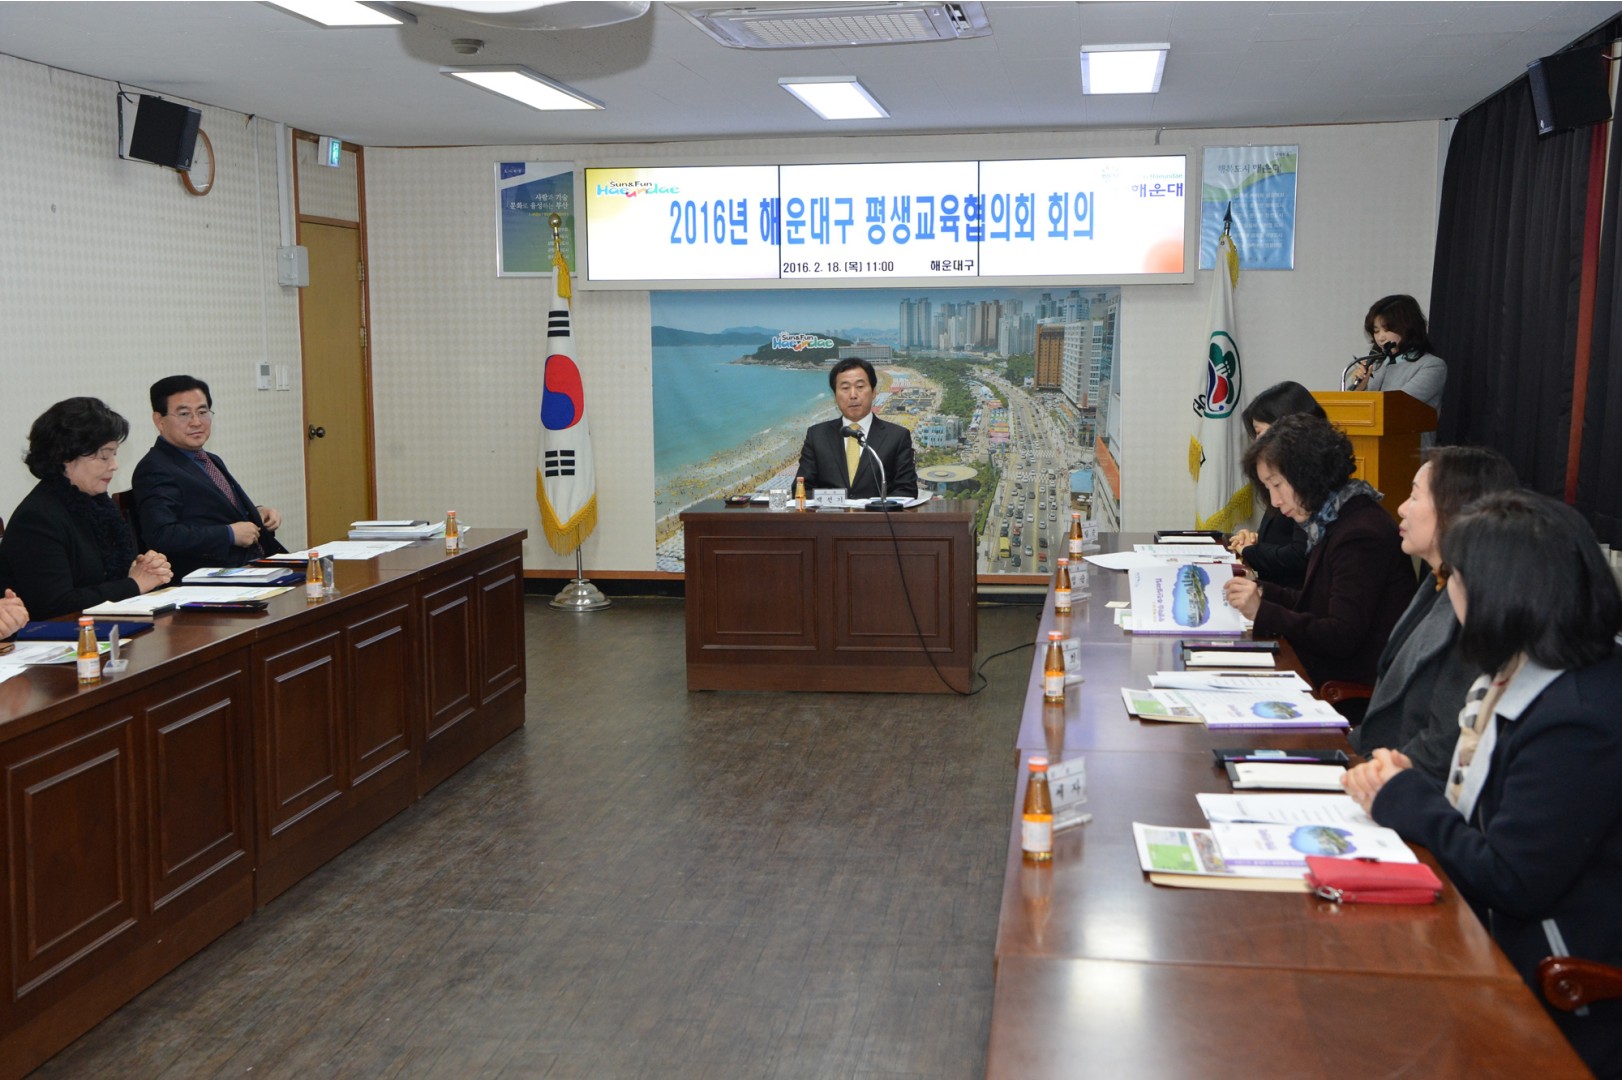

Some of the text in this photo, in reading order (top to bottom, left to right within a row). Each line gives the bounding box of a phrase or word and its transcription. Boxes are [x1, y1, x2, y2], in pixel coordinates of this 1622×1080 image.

[596, 183, 680, 198] Haeundae
[669, 191, 1095, 246] 2016년 해운대구 평생교육협의회 회의
[783, 262, 811, 273] 2016.
[814, 262, 823, 273] 2.
[827, 262, 842, 273] 18.
[866, 261, 894, 272] 11:00
[930, 259, 975, 272] 해운대구
[772, 336, 834, 351] Haeundae
